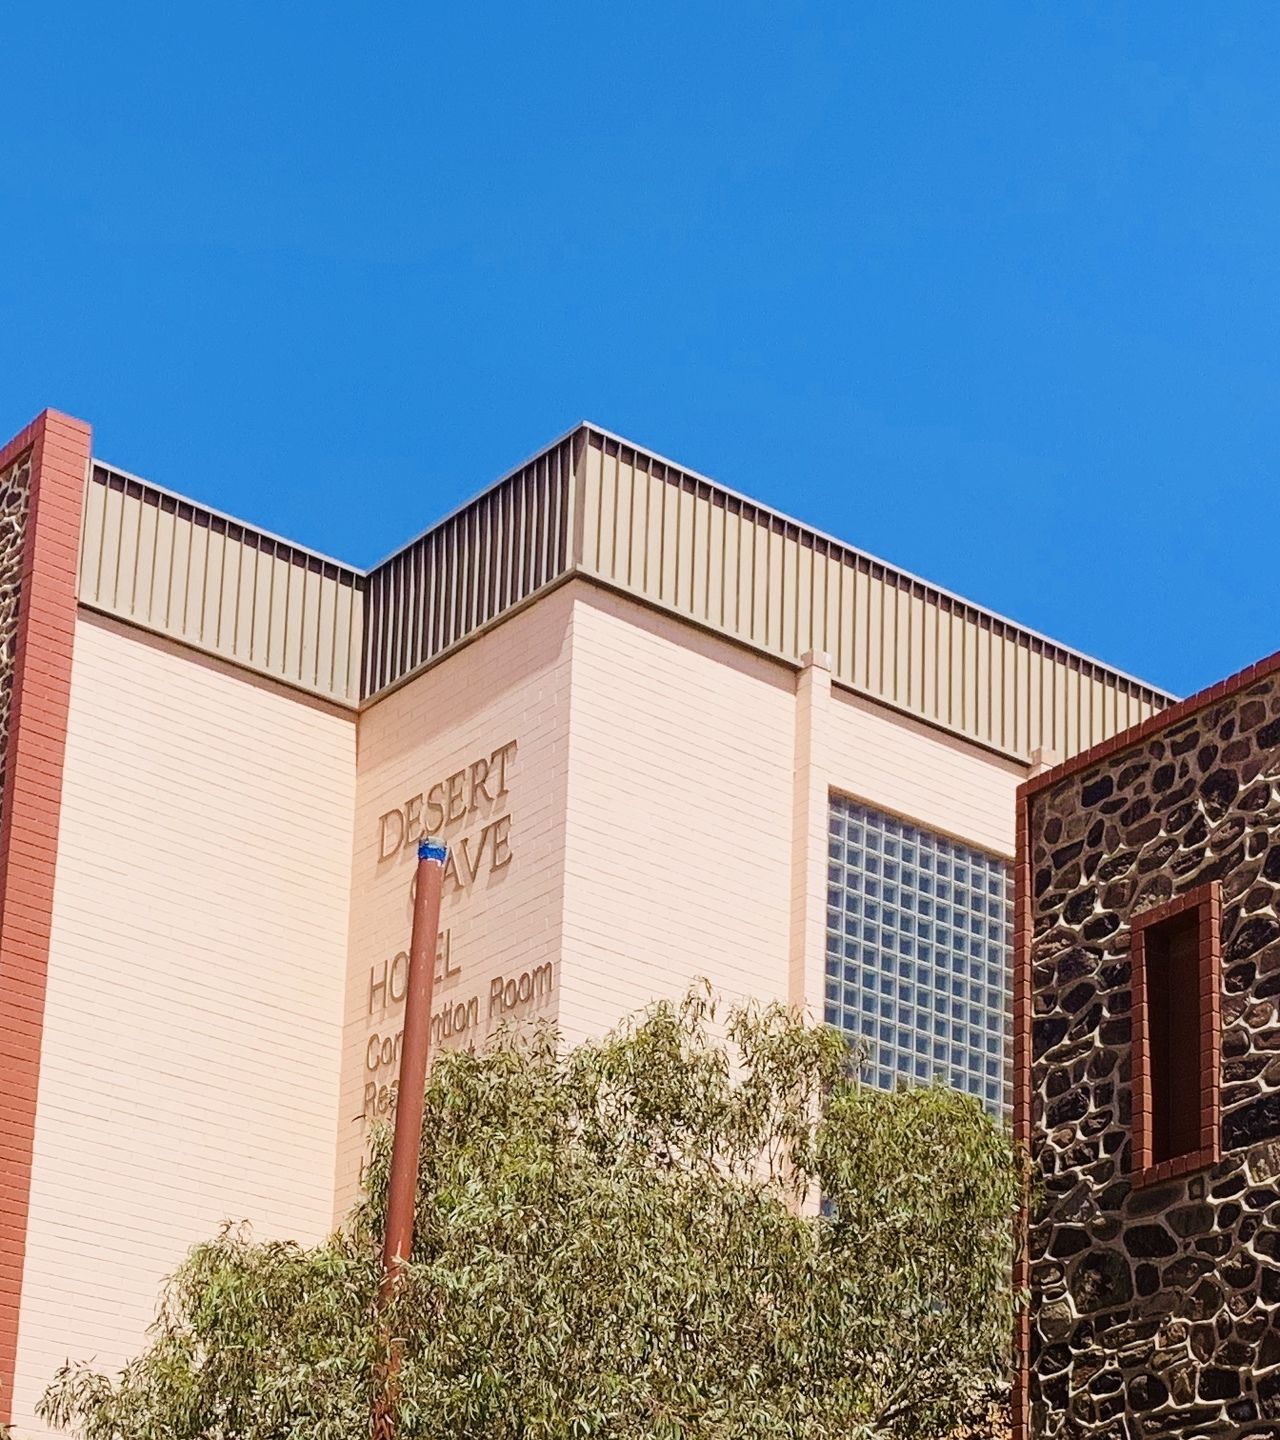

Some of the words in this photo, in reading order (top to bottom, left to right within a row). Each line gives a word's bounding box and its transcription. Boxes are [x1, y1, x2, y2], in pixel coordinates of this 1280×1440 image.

[377, 739, 518, 864] DESERT
[410, 814, 513, 905] AVE
[366, 995, 479, 1072] Conntion
[489, 961, 553, 1018] Room
[369, 928, 462, 1015] HOL
